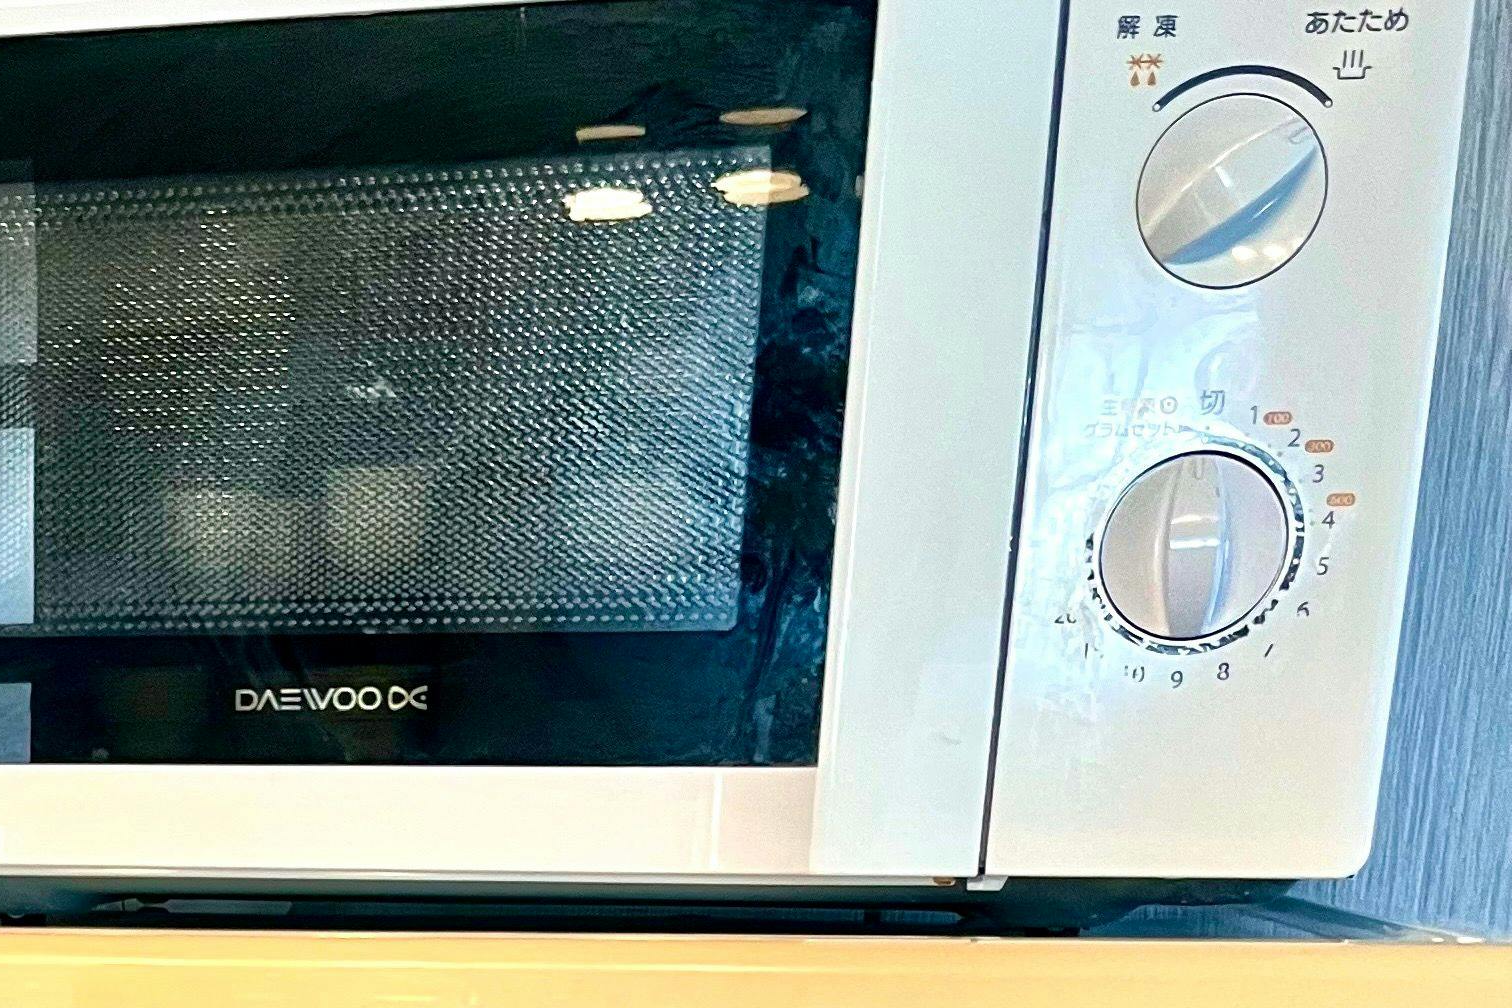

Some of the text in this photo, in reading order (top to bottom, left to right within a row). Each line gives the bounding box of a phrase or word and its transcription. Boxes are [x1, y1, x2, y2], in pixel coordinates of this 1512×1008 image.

[1305, 9, 1410, 34] あたため
[1199, 389, 1226, 416] 切
[1250, 405, 1258, 425] 1
[1287, 428, 1301, 448] 2
[1312, 464, 1324, 483] 3
[1321, 510, 1335, 529] 4
[1317, 556, 1330, 576] 5
[1170, 670, 1184, 689] 9
[1216, 662, 1230, 681] 8
[235, 686, 382, 711] DAEWOO
